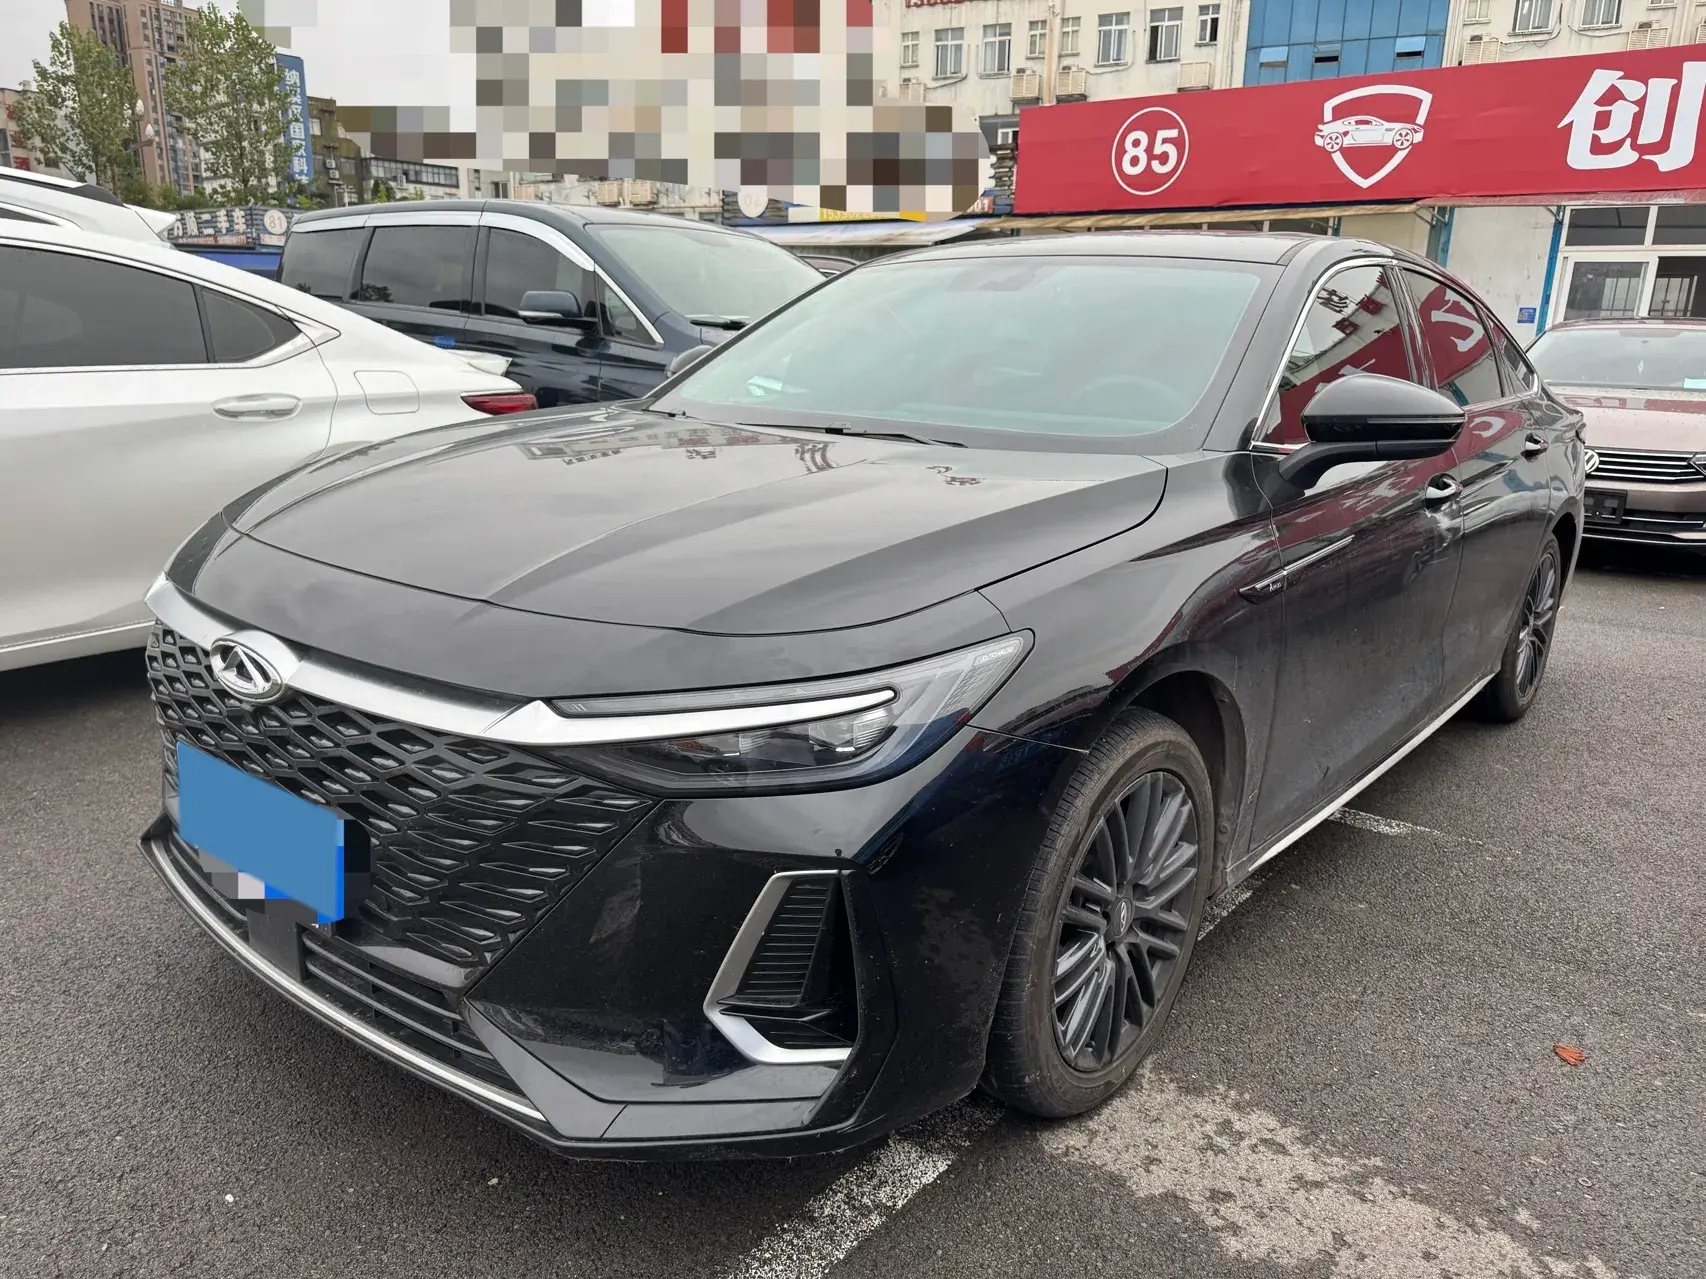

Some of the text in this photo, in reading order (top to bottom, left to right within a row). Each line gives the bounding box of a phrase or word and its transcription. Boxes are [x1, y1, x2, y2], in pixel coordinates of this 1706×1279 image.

[1557, 61, 1706, 172] 创
[1121, 128, 1179, 175] 85
[268, 214, 283, 230] 81
